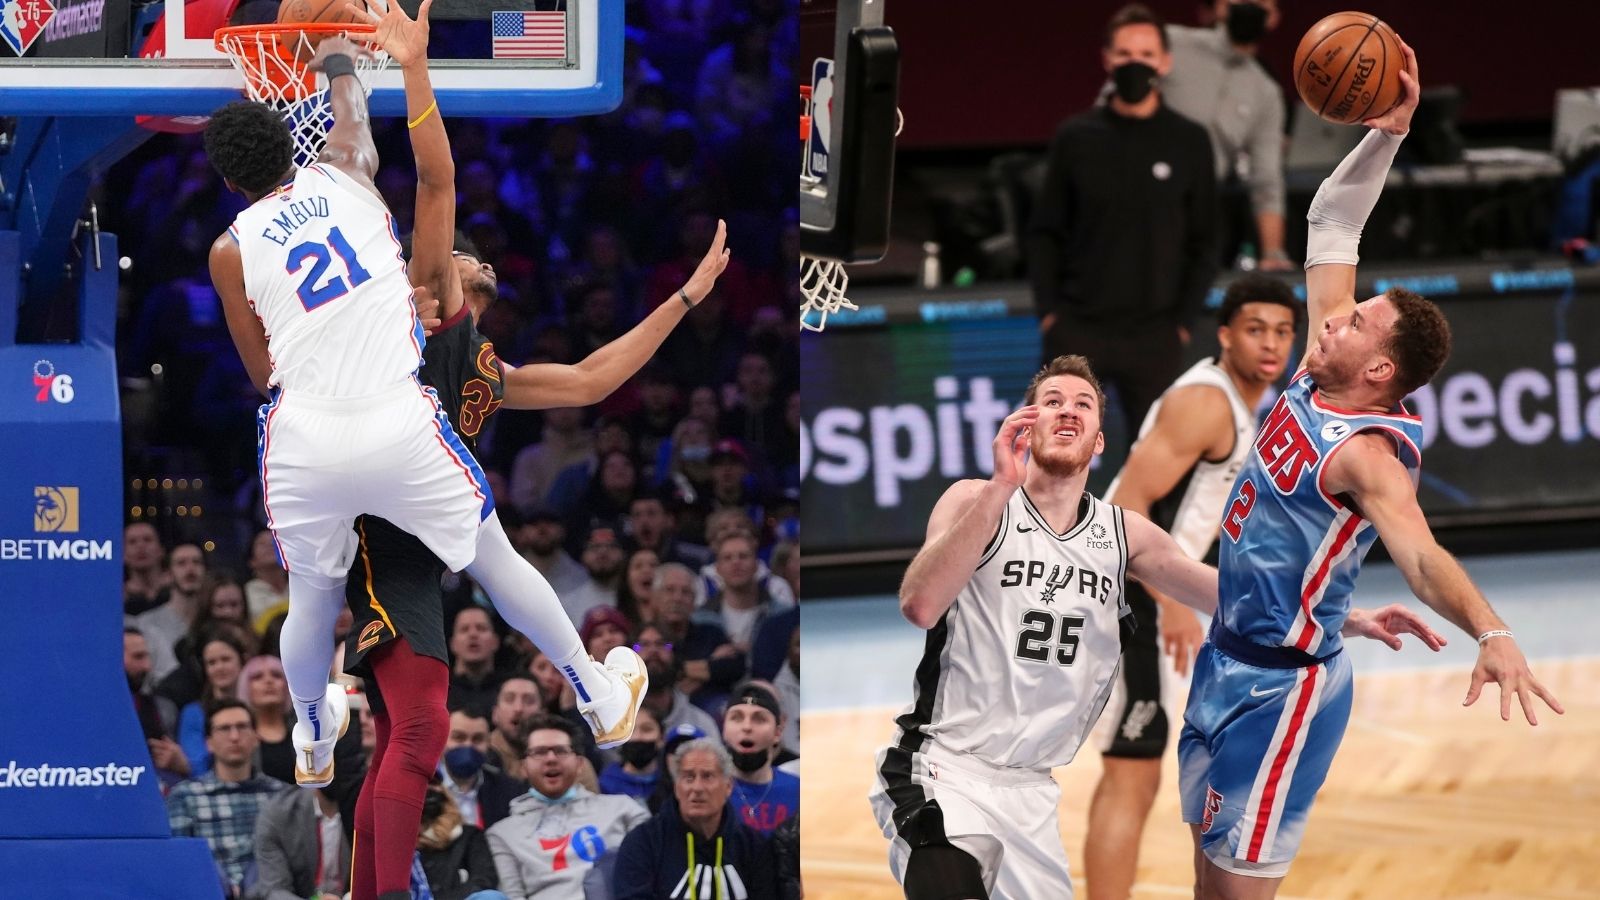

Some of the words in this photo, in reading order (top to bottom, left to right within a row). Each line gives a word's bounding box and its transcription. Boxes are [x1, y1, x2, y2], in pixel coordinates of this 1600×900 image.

[26, 1, 40, 21] 75
[262, 195, 330, 247] EMBIID
[285, 225, 373, 313] 21
[33, 370, 75, 404] 76
[800, 376, 1010, 507] spit
[1254, 391, 1321, 496] NETS
[1222, 478, 1257, 544] 2
[1, 539, 112, 560] BETMGM
[1086, 536, 1113, 550] Frost
[1000, 560, 1113, 606] SPURS
[1014, 608, 1087, 668] 25
[539, 825, 607, 874] 76
